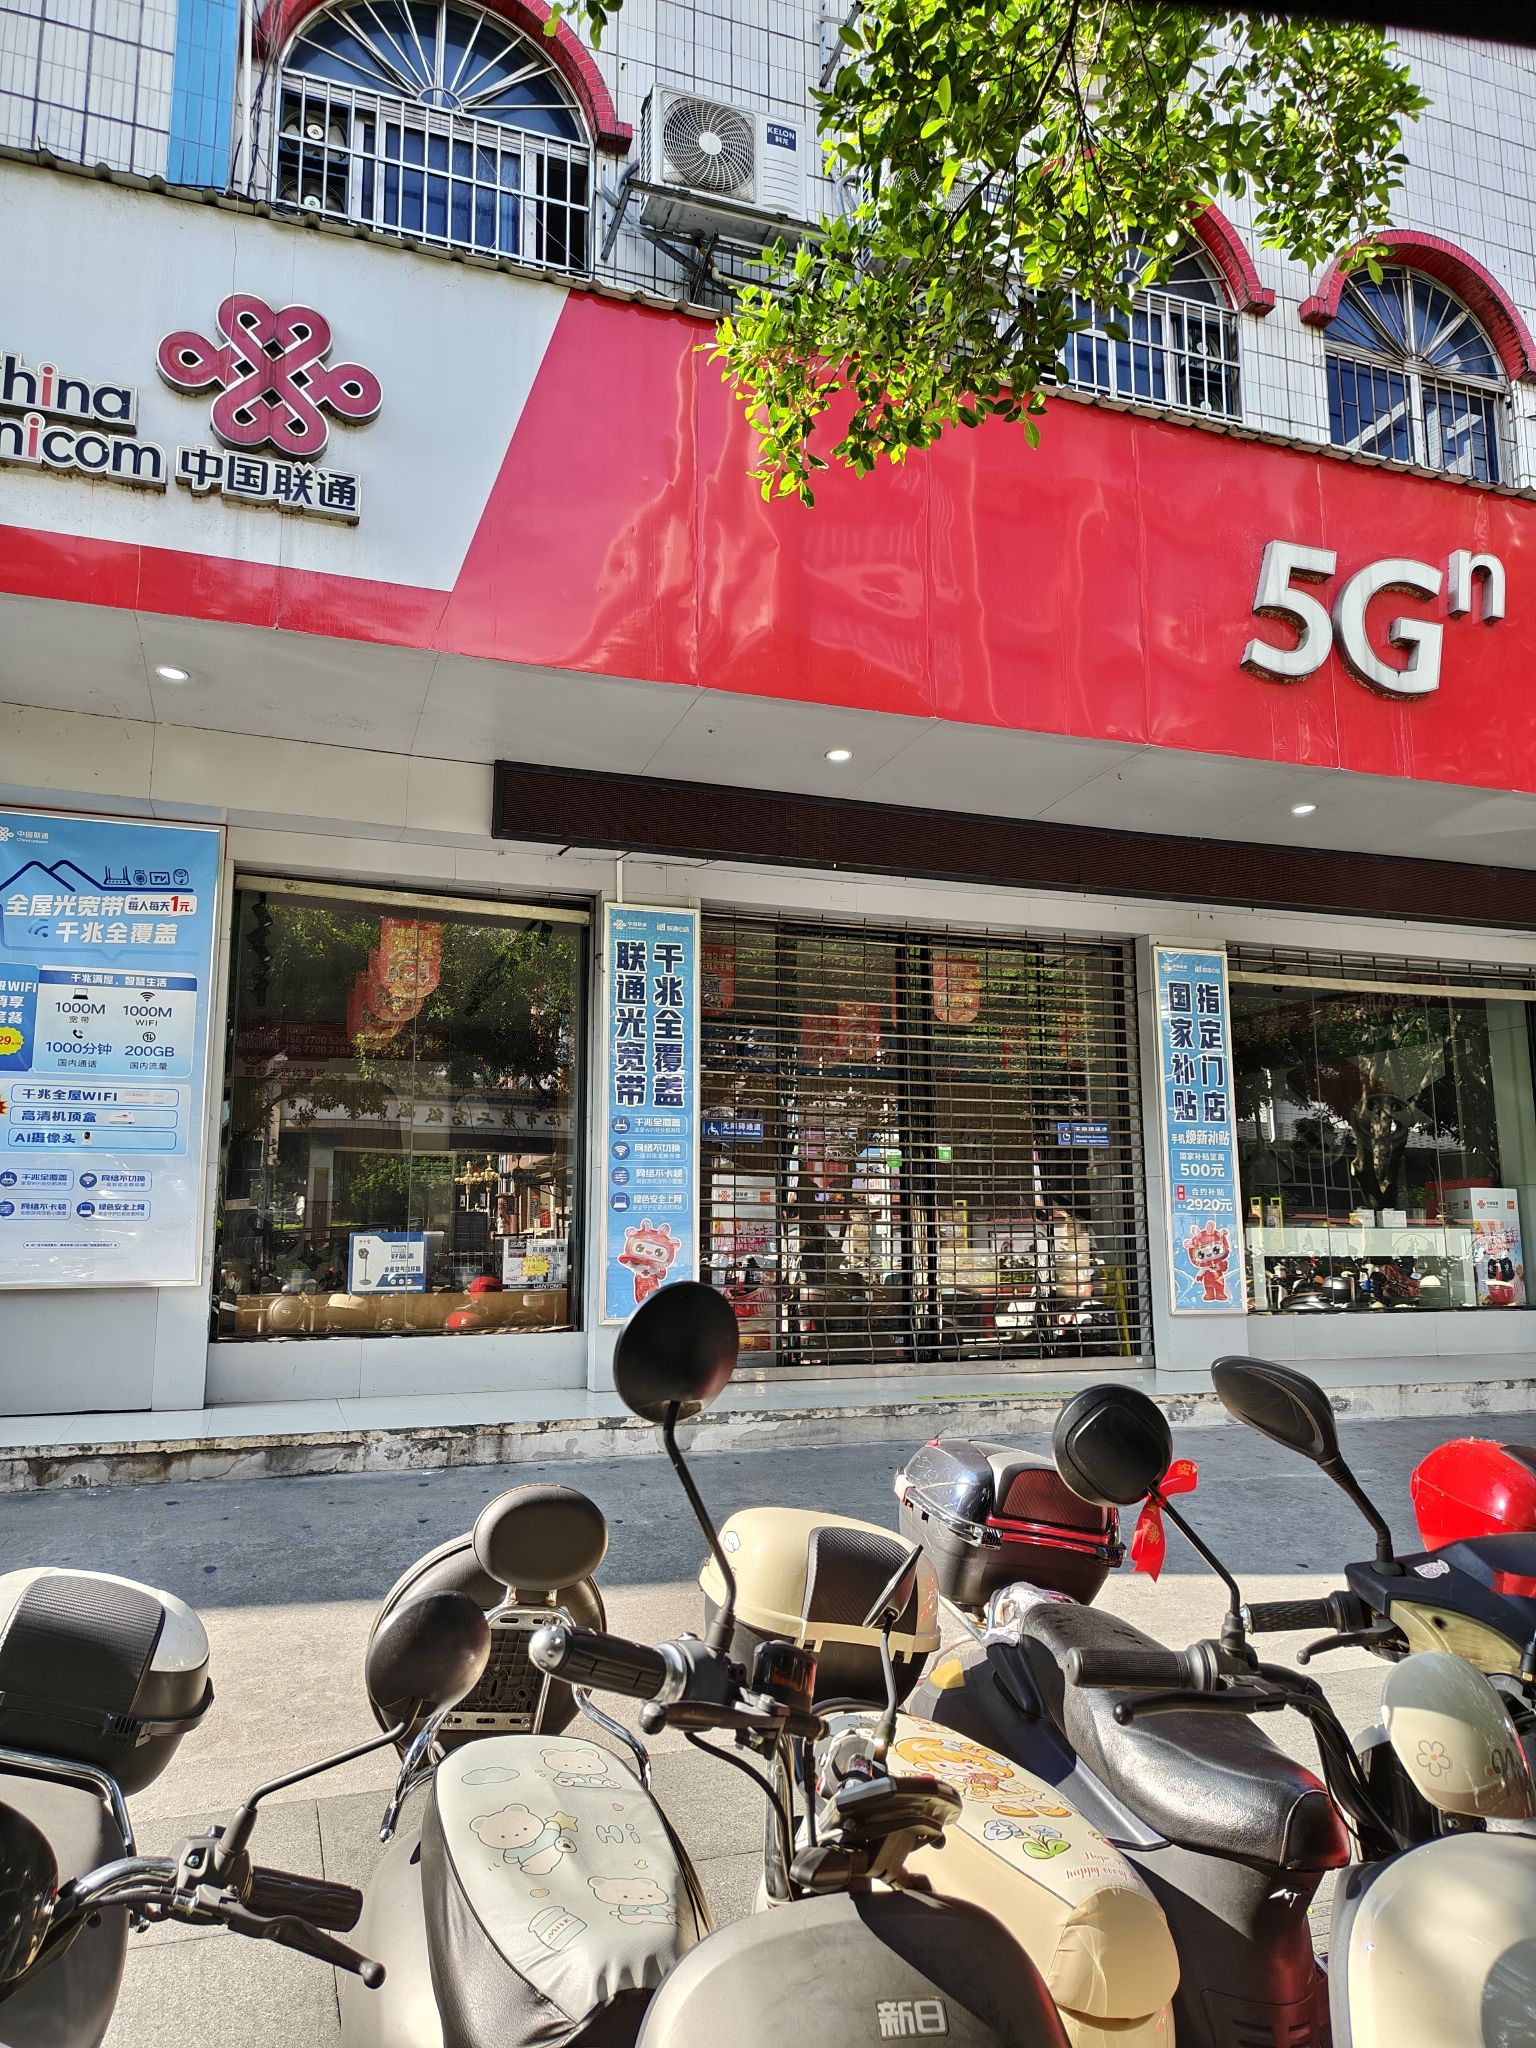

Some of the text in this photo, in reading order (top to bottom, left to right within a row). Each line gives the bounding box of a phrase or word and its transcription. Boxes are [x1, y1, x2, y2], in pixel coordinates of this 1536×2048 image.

[767, 126, 795, 140] KELON
[0, 356, 132, 421] hina
[181, 449, 357, 512] 中国联通
[17, 830, 48, 840] 中国联通
[4, 894, 124, 917] 全屋光宽带
[128, 896, 190, 912] 每人每天1元
[56, 921, 179, 945] 千兆全覆盖
[55, 1002, 106, 1015] 1000M
[123, 1005, 172, 1018] 1000M
[69, 1015, 90, 1024] 宽带
[616, 941, 647, 1107] 联通光宽带
[654, 943, 684, 1108] 千兆全覆盖
[45, 1041, 112, 1055] 1000分钟
[124, 1046, 175, 1057] 200GB
[1168, 981, 1198, 1122] 国家补贴
[1196, 983, 1226, 1123] 指定门店
[58, 1059, 97, 1069] 国内通话
[129, 1061, 168, 1070] 国内流量
[22, 1088, 118, 1102] 千兆全屋WIFI
[21, 1110, 97, 1123] 高清机顶盒
[634, 1118, 681, 1127] 千兆全覆盖
[14, 1132, 77, 1144] AI摄像头
[1171, 1129, 1230, 1146] 手机焕新补贴
[634, 1143, 681, 1153] 网络不切换
[636, 1168, 683, 1178] 网络不卡顿
[1180, 1164, 1225, 1177] 500元
[101, 1174, 146, 1182] 网络不切换
[1191, 1187, 1225, 1196] 合约补贴
[634, 1195, 682, 1204] 绿色安全上网
[1186, 1199, 1233, 1212] 2920元
[98, 1203, 145, 1211] 绿色安全上网
[596, 1824, 640, 1844] Hi
[1066, 1866, 1100, 1880] happy
[548, 1917, 573, 1940] MILK
[877, 2000, 946, 2037] 新日
